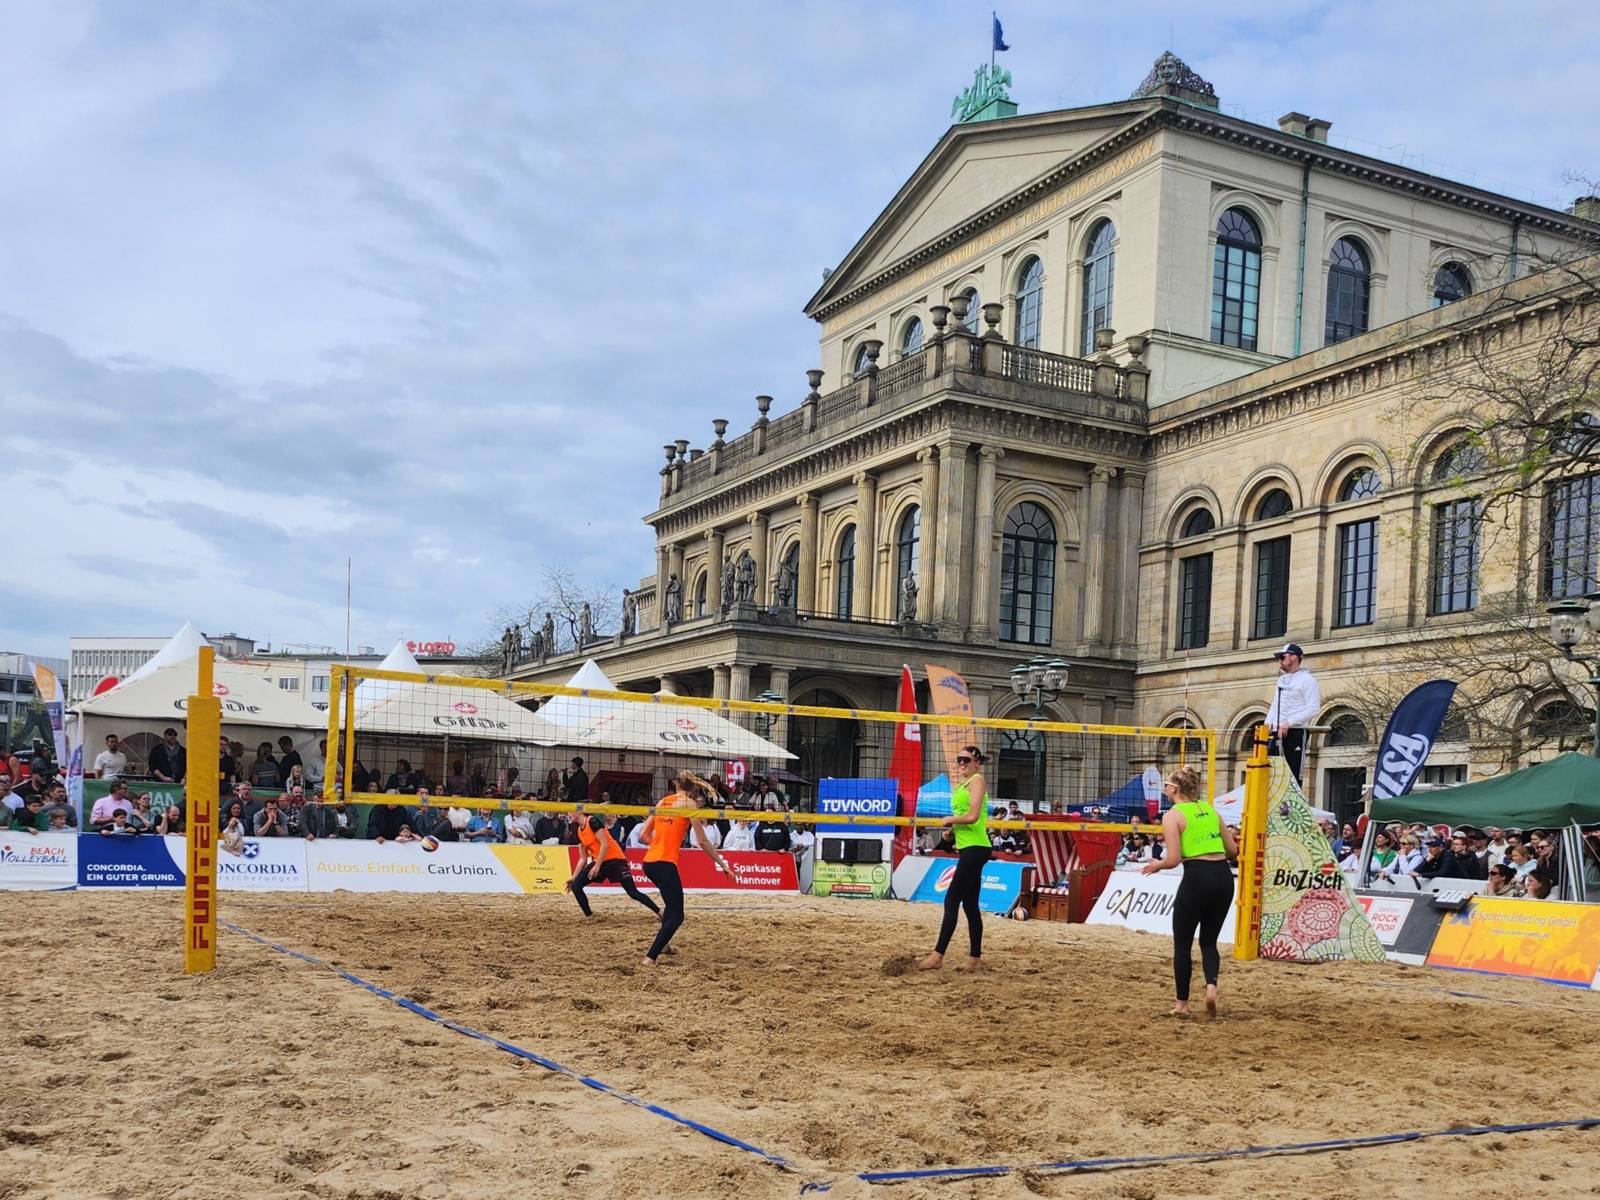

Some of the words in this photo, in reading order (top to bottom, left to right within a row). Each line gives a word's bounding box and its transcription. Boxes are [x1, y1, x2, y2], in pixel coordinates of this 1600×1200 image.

[417, 641, 456, 654] LOTTO
[0, 850, 70, 863] VOLLEYBALL
[30, 847, 65, 856] BEACH
[86, 864, 147, 872] CONCORDIA.
[216, 863, 298, 874] ONCORDIA
[316, 861, 364, 874] Autos.
[367, 862, 425, 875] Einfach.
[427, 863, 498, 876] CarUnion.
[733, 863, 782, 874] Sparkasse
[86, 873, 104, 881] EIN
[105, 873, 139, 881] GUTER
[140, 873, 177, 881] GRUND.
[193, 800, 210, 950] FUNTEC
[219, 874, 300, 882] rsicherungen
[735, 876, 781, 886] Hannover
[1371, 913, 1400, 923] ROCK
[1376, 923, 1396, 932] POP
